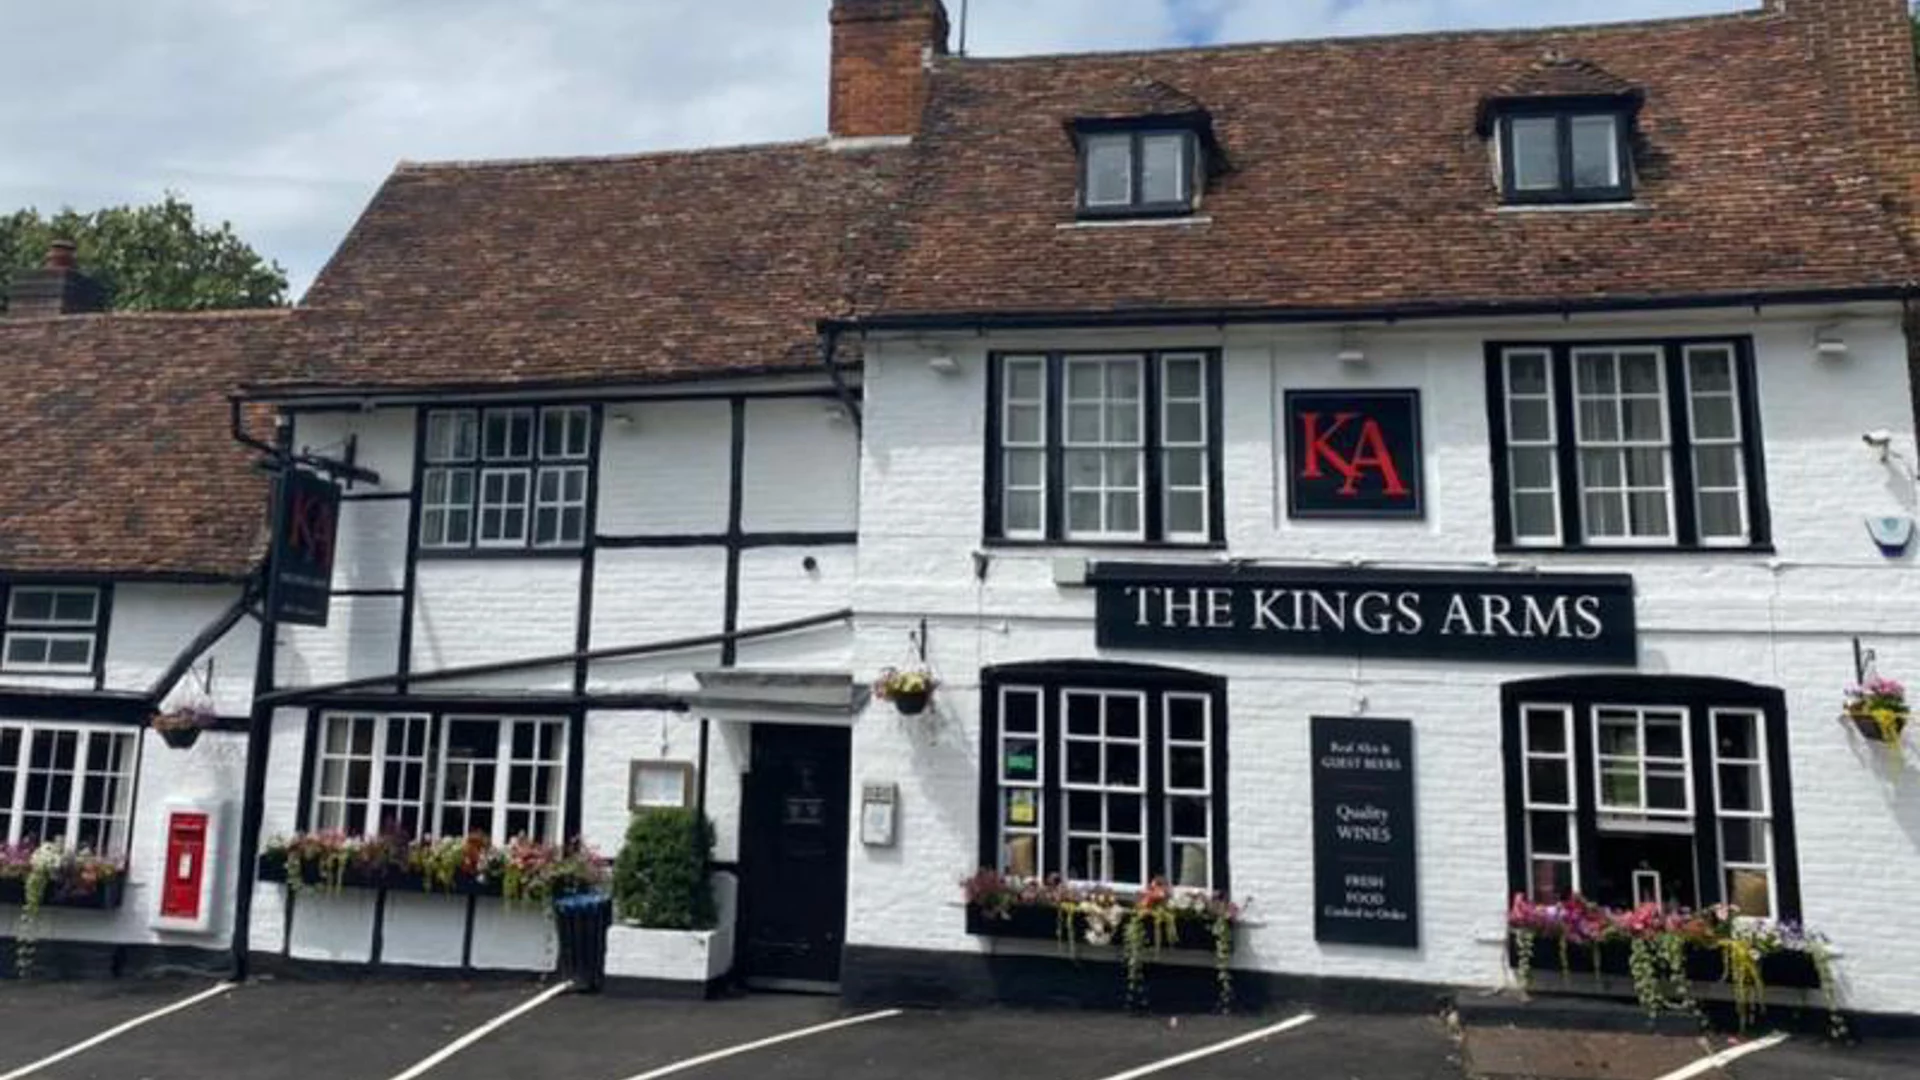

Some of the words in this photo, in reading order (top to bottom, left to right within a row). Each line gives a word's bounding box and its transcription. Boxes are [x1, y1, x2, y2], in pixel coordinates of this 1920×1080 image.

[1298, 411, 1411, 498] KA
[1125, 587, 1233, 628] THE
[1251, 590, 1423, 635] KINGS
[1439, 594, 1603, 639] ARMS
[1321, 756, 1361, 769] GUEST
[1363, 758, 1402, 771] BEERS
[1335, 804, 1389, 826] Quality
[1336, 824, 1392, 843] WINES
[1344, 874, 1385, 890] FRESH
[1345, 891, 1386, 906] FOOD
